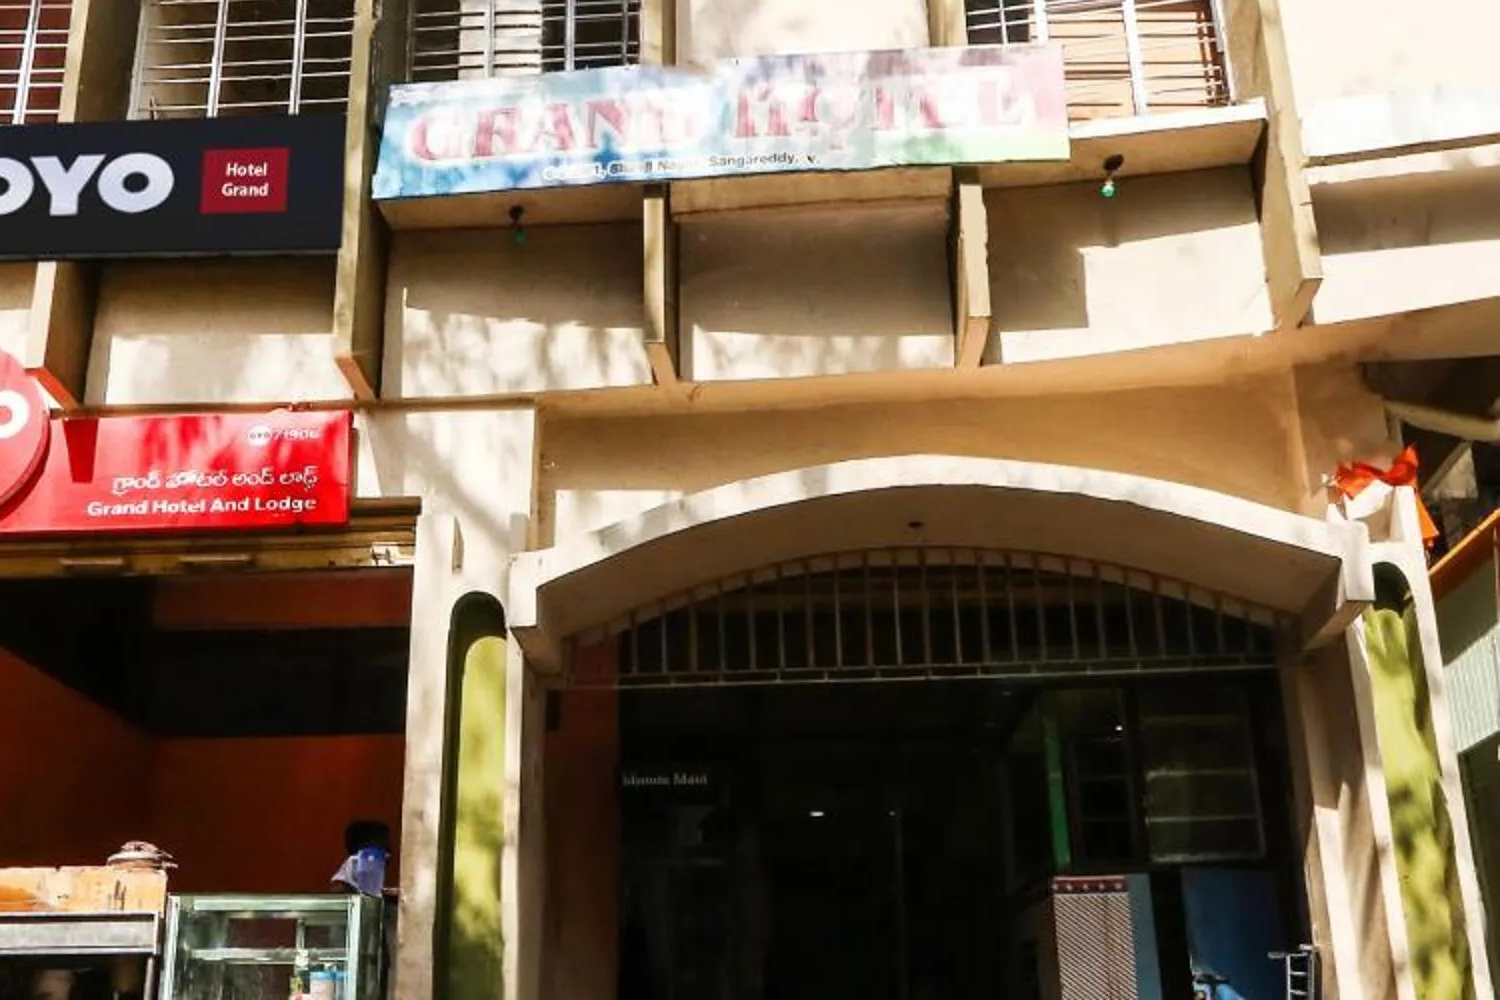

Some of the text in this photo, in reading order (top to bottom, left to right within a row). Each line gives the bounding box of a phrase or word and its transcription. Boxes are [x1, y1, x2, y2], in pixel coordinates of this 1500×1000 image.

[226, 161, 268, 177] Hotel
[221, 182, 270, 197] Grand
[87, 494, 318, 517] Grand Hotel And Lodge
